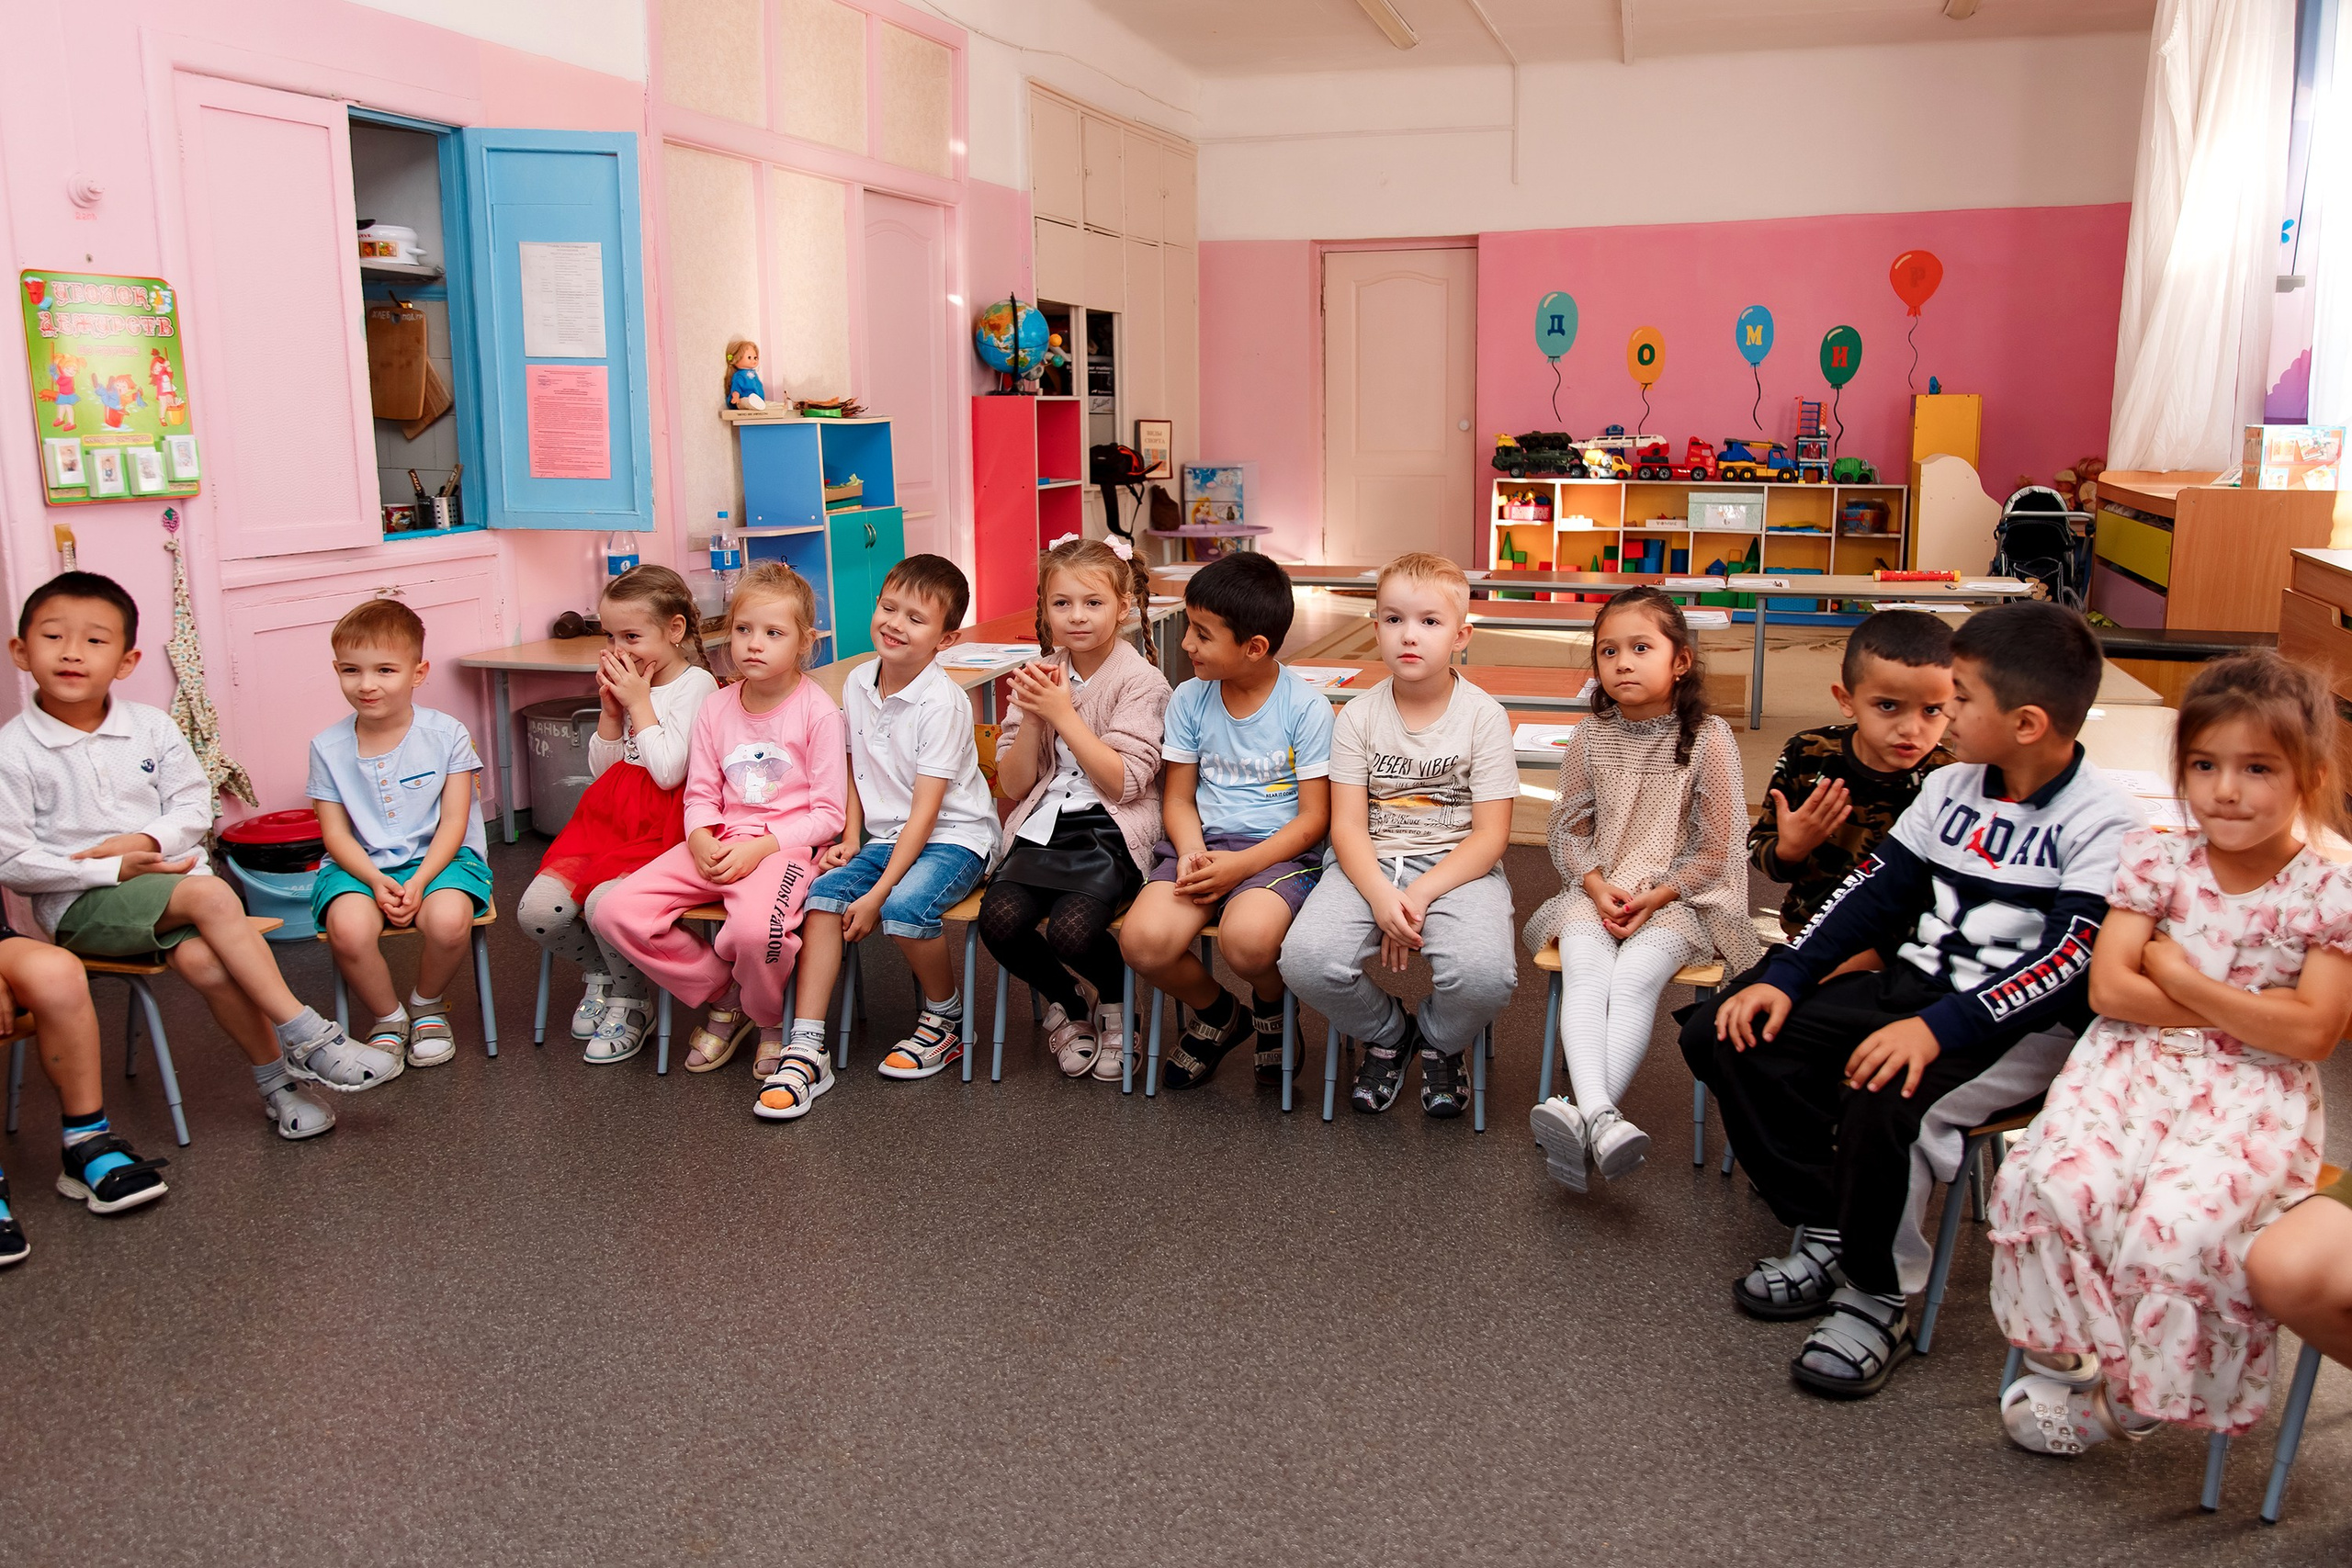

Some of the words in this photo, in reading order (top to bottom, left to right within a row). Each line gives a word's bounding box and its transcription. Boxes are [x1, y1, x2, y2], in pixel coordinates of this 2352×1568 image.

[39, 310, 174, 339] ДЕЖУРСТВ
[1547, 314, 1566, 336] Д
[1637, 343, 1656, 366] О
[1746, 324, 1763, 345] М
[1831, 346, 1849, 367] И
[1910, 266, 1926, 288] Р
[1373, 752, 1413, 775] DESERT
[1419, 754, 1459, 778] VIBES
[776, 861, 805, 908] Almost
[765, 905, 786, 964] Famous
[1990, 940, 2086, 1016] JORDAN
